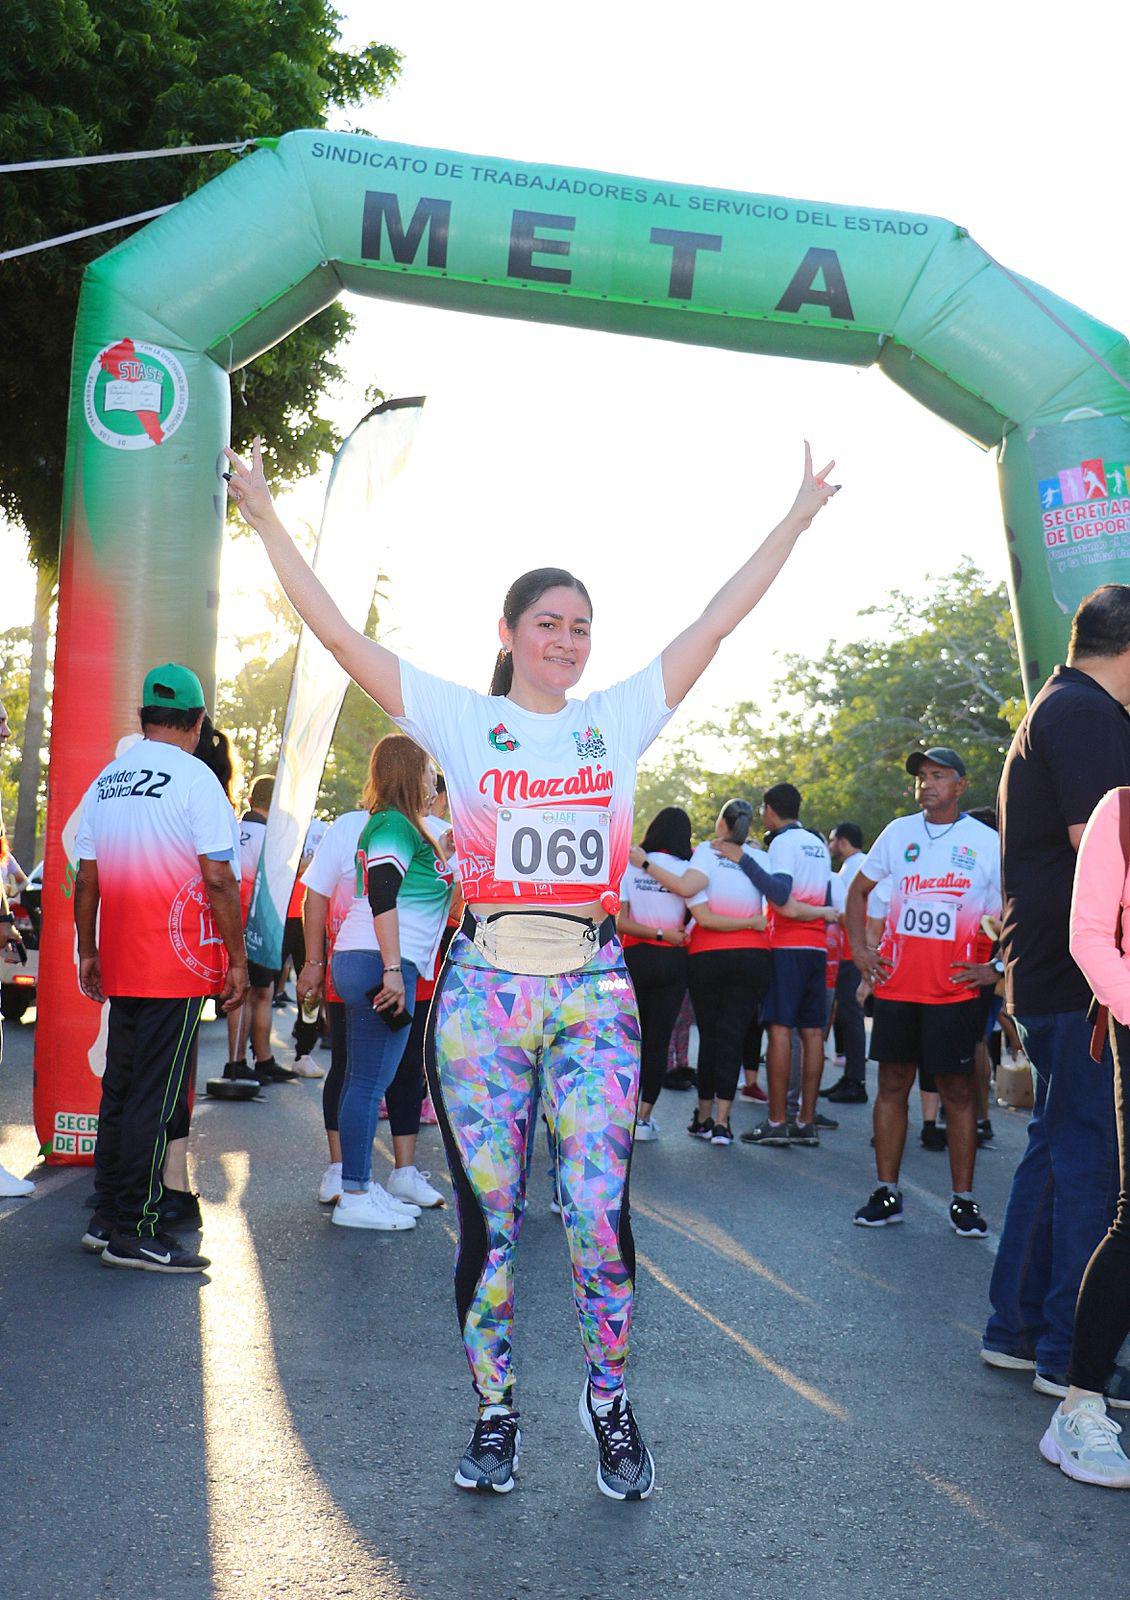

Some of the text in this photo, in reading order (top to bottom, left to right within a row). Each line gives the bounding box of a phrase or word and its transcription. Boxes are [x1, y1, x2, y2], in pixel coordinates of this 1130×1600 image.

[311, 142, 929, 236] SINDICATO DE TRABAJADORES AL SERVICIO DEL ESTADO
[360, 190, 856, 322] META
[1046, 528, 1066, 546] DE
[130, 769, 171, 798] 22
[479, 763, 614, 804] Mazatlán
[511, 826, 604, 877] 069
[904, 908, 951, 936] 099
[57, 1114, 98, 1131] SECR
[55, 1136, 75, 1151] DE
